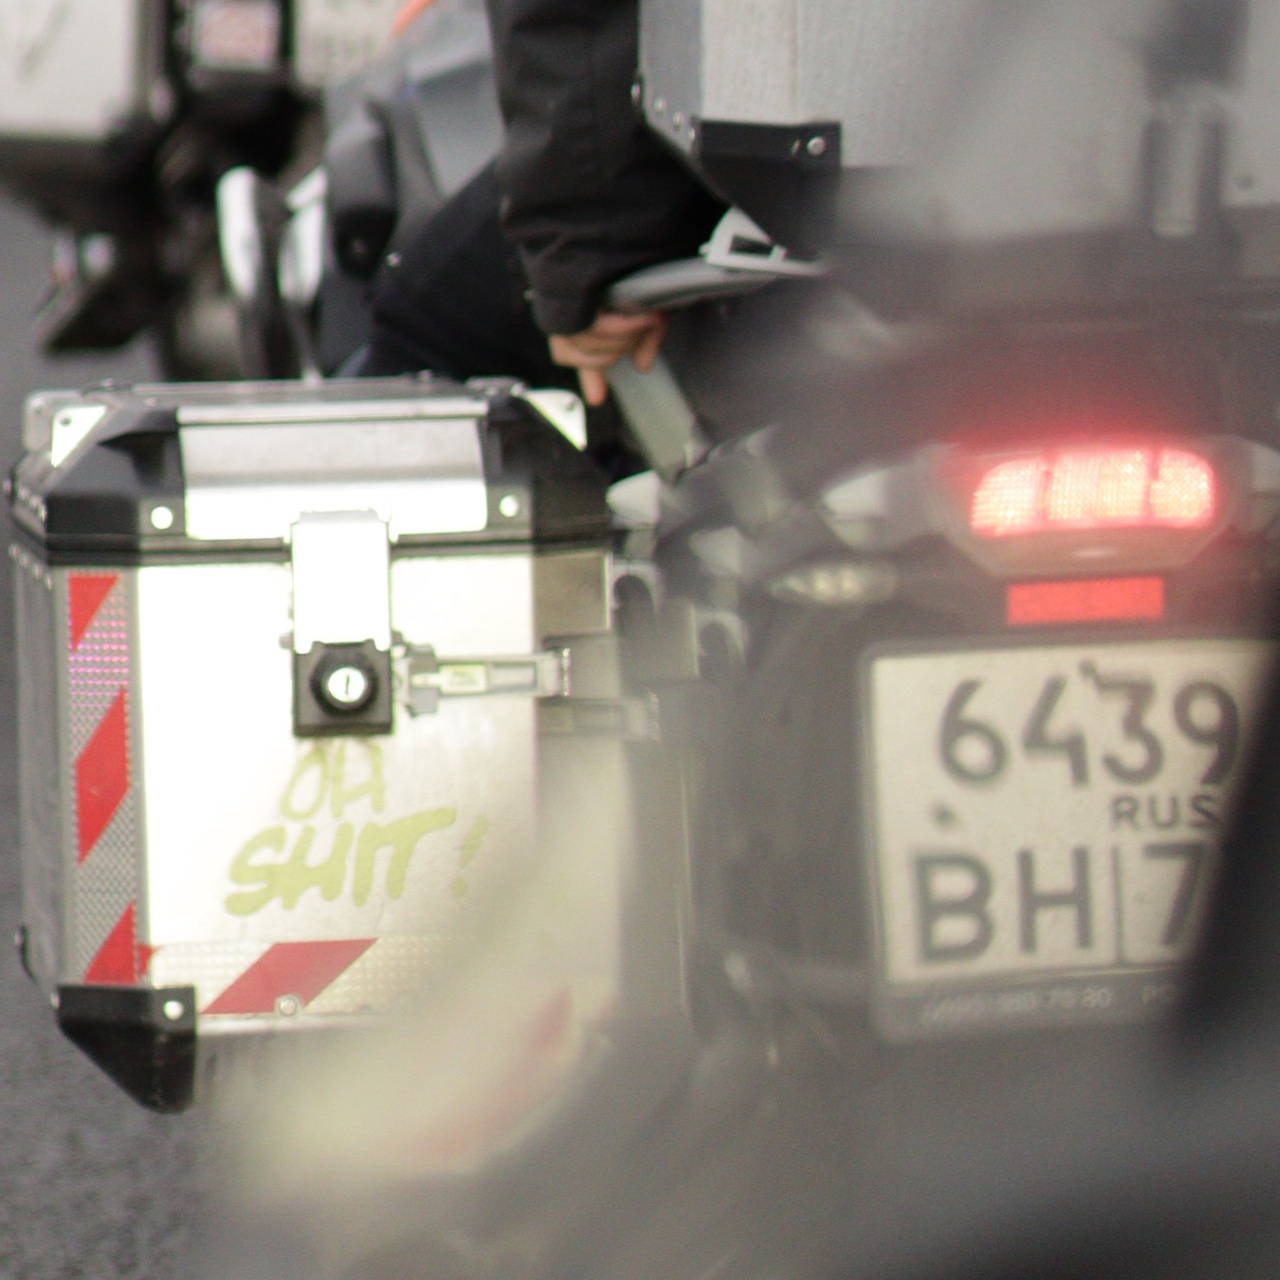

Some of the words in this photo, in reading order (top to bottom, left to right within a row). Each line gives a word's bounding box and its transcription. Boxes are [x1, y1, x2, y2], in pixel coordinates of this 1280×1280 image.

[938, 676, 1242, 789] 6439
[278, 742, 387, 822] OH
[1111, 793, 1219, 831] RUS
